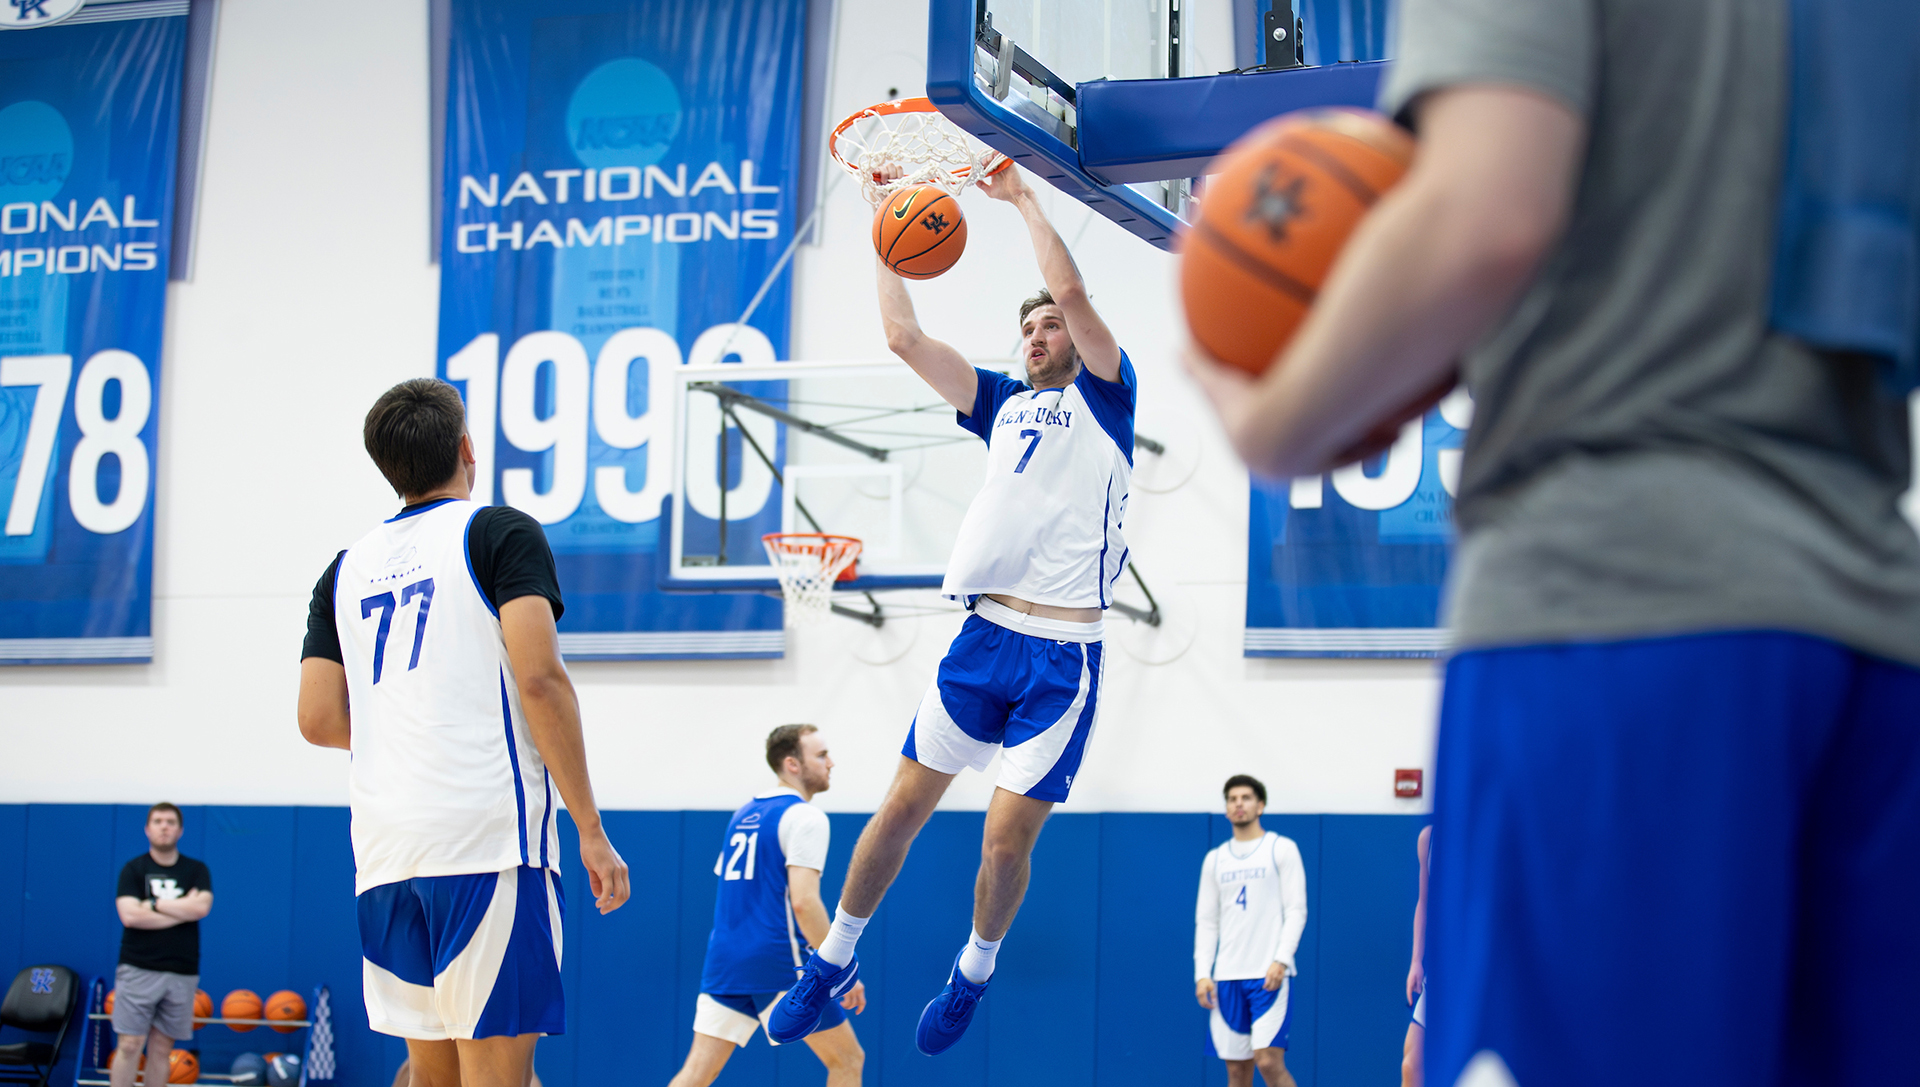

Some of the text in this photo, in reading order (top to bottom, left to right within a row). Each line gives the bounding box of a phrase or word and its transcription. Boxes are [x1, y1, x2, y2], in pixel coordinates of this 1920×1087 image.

[9, 0, 51, 20] K
[458, 159, 780, 210] NATIONAL
[1, 194, 160, 235] ONAL
[456, 208, 779, 254] CHAMPIONS
[0, 241, 158, 278] PIONS
[0, 348, 152, 536] 78
[446, 323, 778, 526] 1996
[1014, 428, 1043, 474] 7
[360, 577, 436, 686] 77
[724, 831, 759, 881] 21
[1235, 884, 1247, 911] 4
